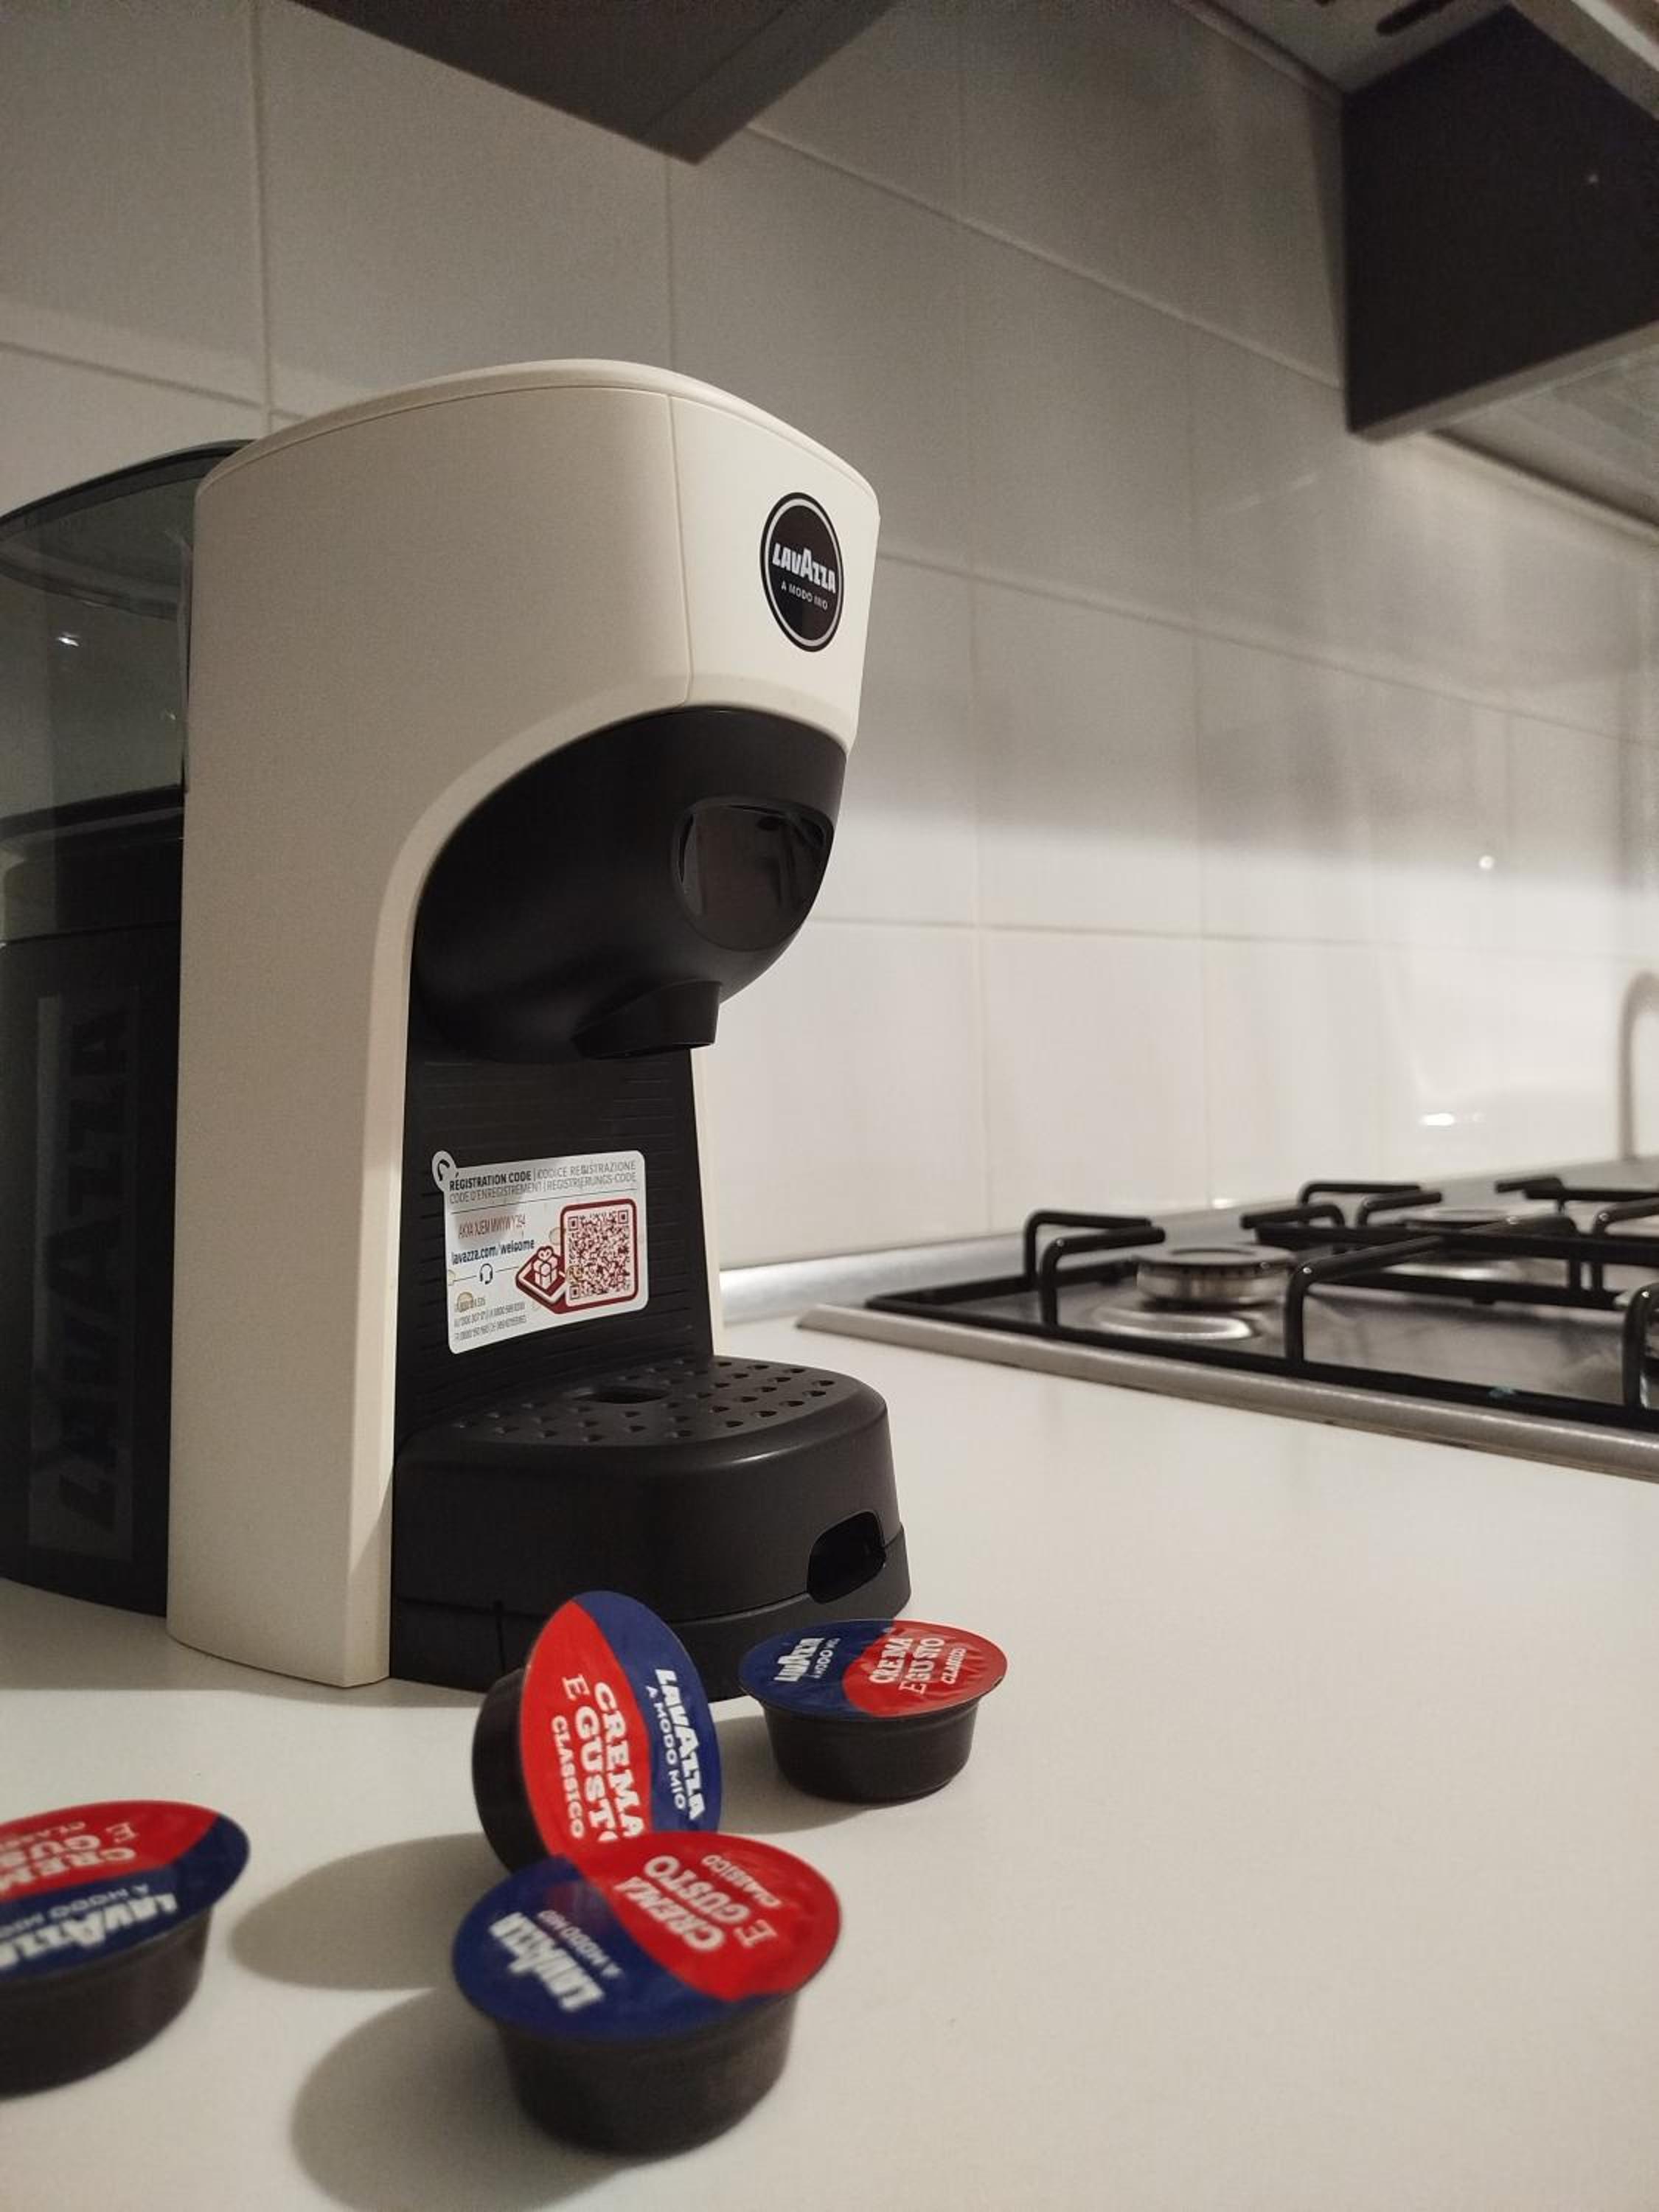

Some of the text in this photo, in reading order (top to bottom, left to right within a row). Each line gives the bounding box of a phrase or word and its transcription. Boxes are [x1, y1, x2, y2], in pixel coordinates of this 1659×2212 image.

[772, 543, 836, 593] LAVAZZA
[781, 580, 827, 610] A MODO MIO
[509, 1171, 531, 1183] CODE
[868, 1637, 914, 1684] CREMA
[899, 1637, 946, 1696] E GUSTO
[563, 1674, 590, 1700] E
[594, 1682, 644, 1837] CREMA
[647, 1686, 686, 1810] A MODO MIO
[655, 1669, 705, 1820] LAVAZZA
[552, 1715, 585, 1839] CLASSICO
[106, 1822, 139, 1843] E
[48, 1888, 130, 1919] MODO
[132, 1883, 148, 1896] A
[644, 1855, 779, 1948] E GUSTO
[702, 1854, 783, 1908] CLASSICO
[613, 1876, 726, 1951] CREMA
[599, 1959, 624, 1978] A
